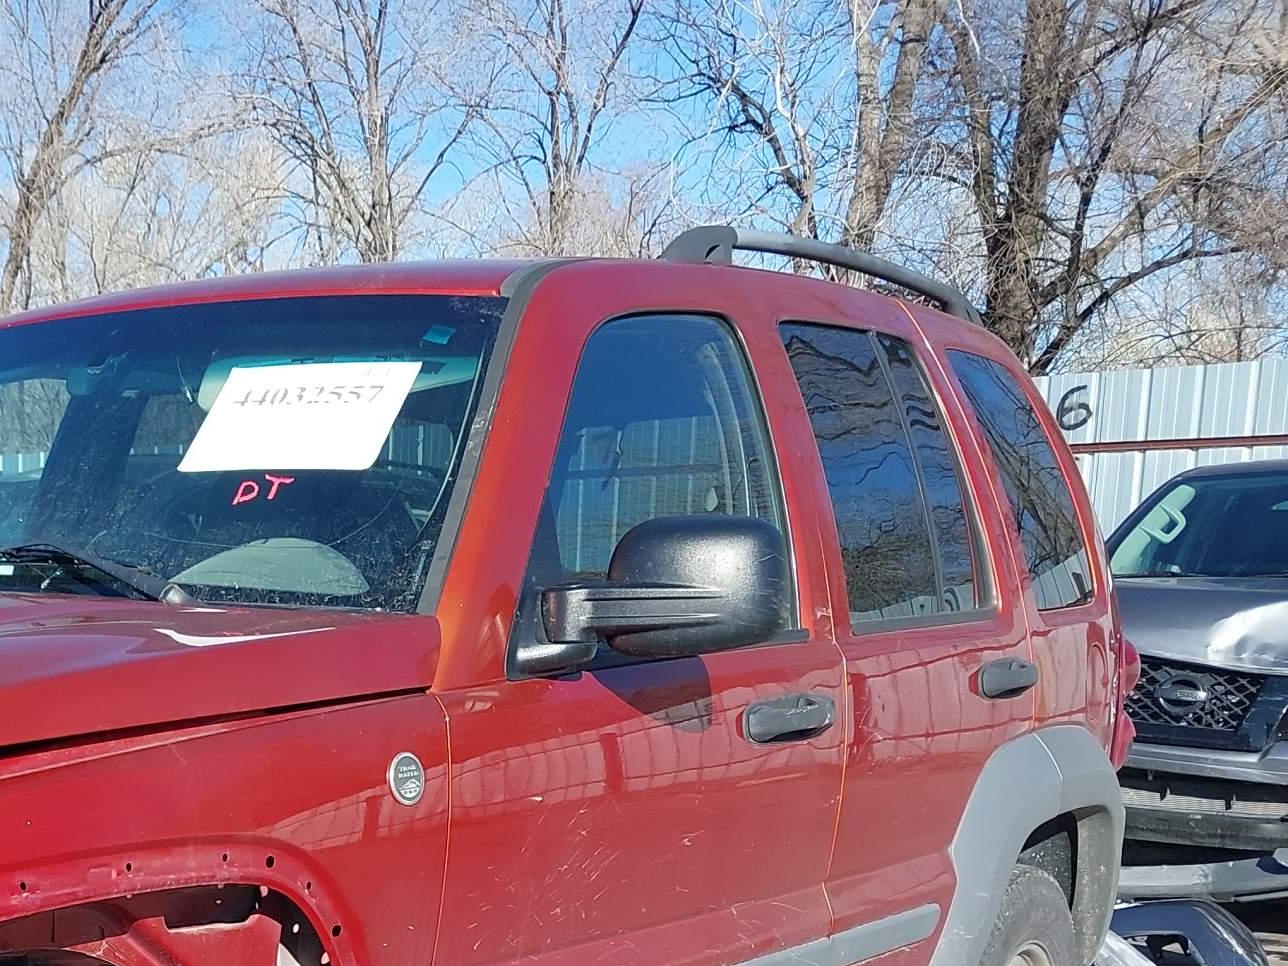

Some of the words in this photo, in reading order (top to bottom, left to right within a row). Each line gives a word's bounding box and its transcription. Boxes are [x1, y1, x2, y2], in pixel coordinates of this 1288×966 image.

[233, 385, 385, 408] 44032557
[1044, 385, 1093, 431] 6
[231, 474, 295, 506] DT
